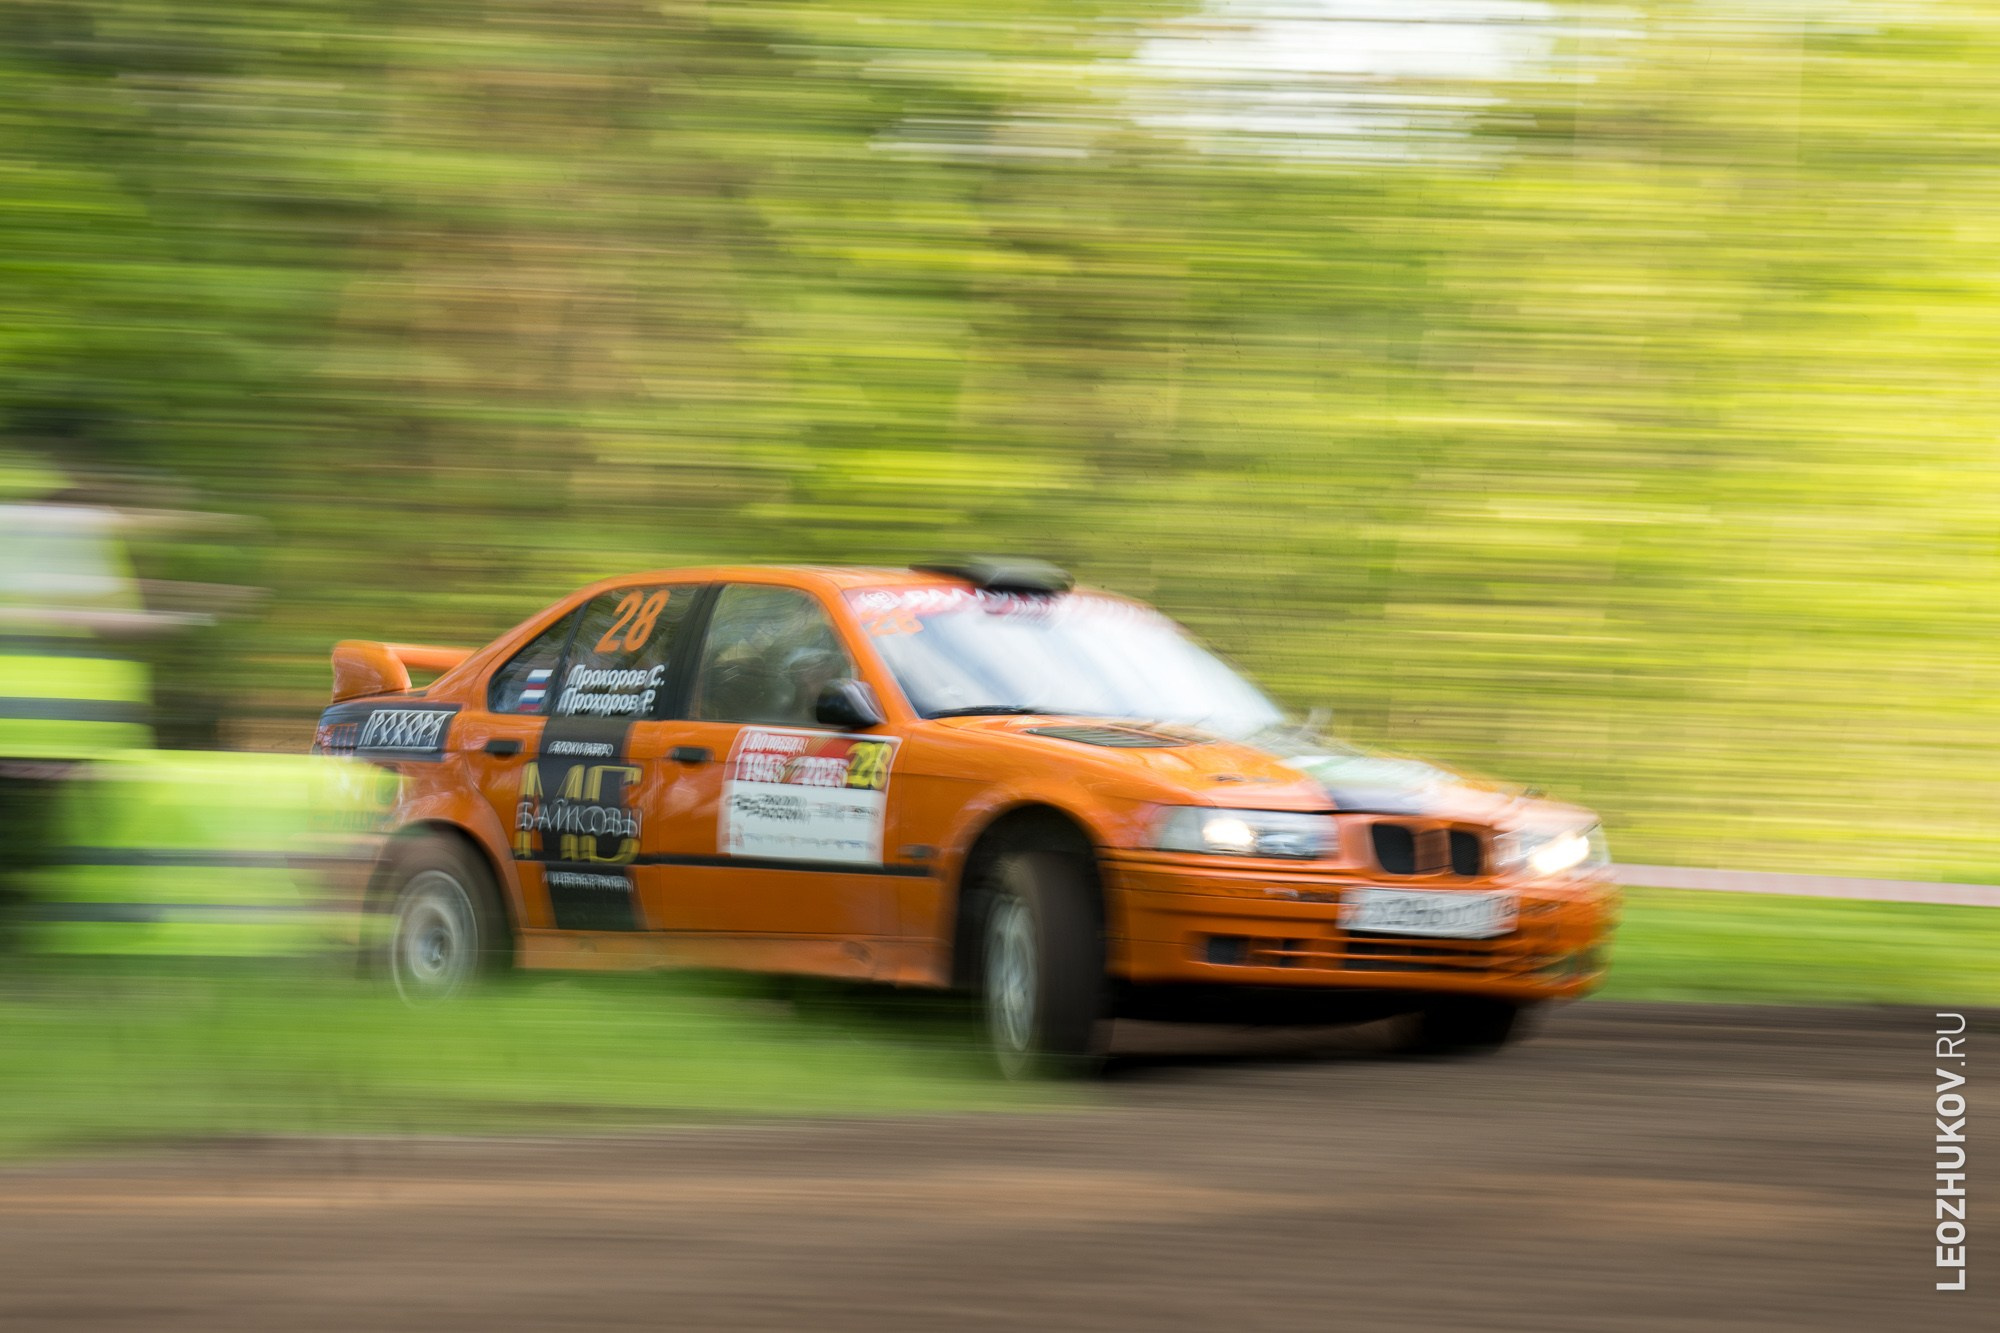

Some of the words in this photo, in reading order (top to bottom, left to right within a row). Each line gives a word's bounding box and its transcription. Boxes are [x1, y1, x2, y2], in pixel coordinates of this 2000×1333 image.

[594, 589, 671, 653] 28
[565, 664, 647, 691] Прохоров
[646, 664, 666, 687] С.
[557, 688, 640, 717] Прохоров
[640, 689, 656, 715] Р.
[846, 742, 893, 790] 28
[516, 798, 643, 838] БАЙКОВЫ
